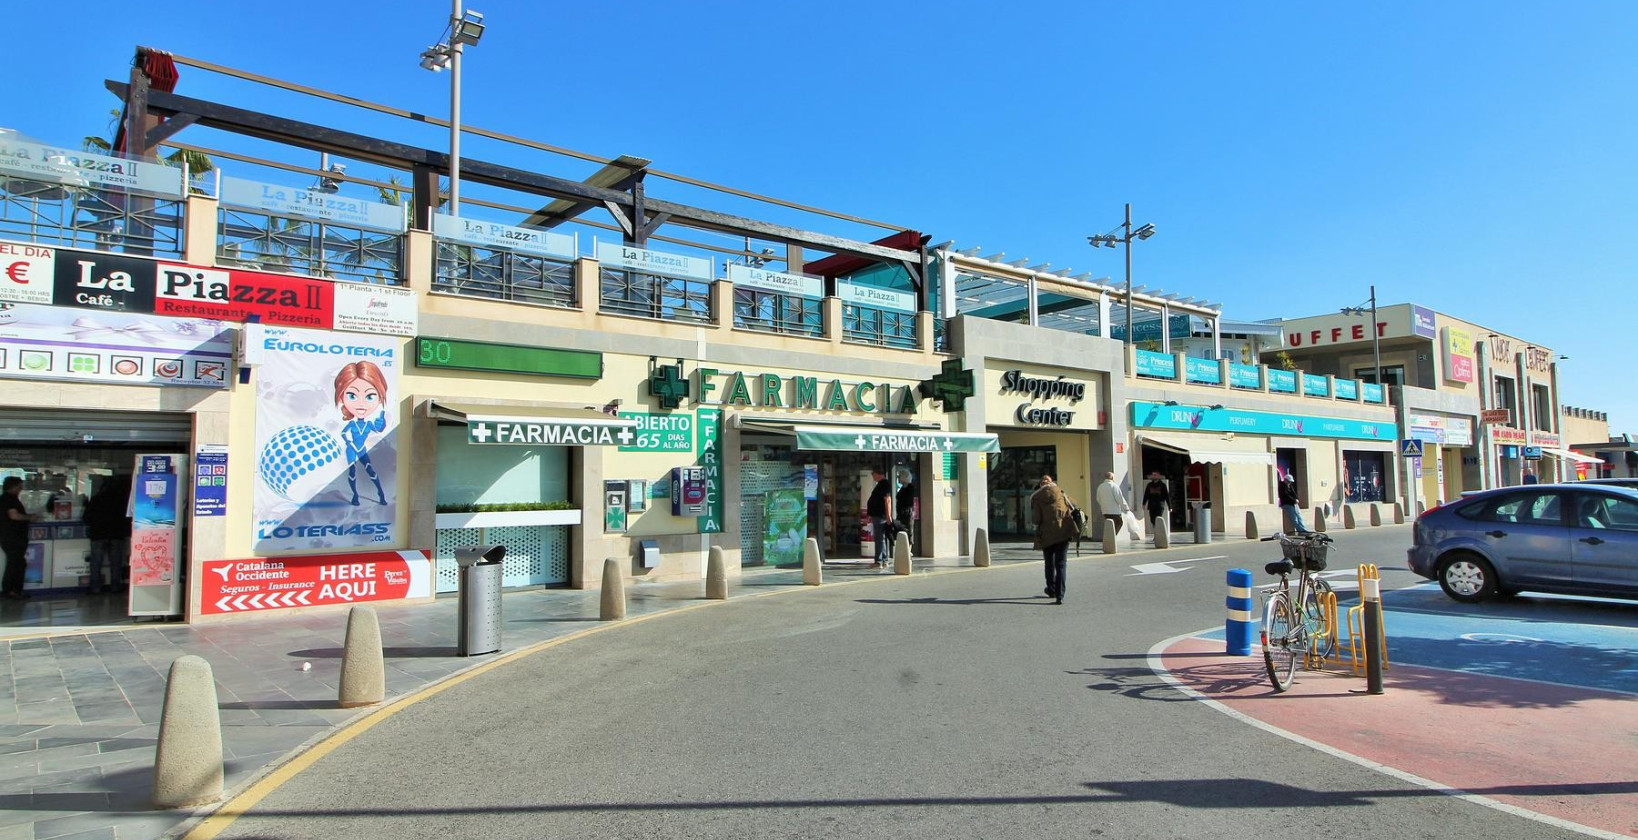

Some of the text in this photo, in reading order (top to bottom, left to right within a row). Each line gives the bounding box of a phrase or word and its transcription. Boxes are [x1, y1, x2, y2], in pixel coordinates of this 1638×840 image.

[261, 185, 286, 202] La
[295, 191, 357, 214] Piazza
[463, 220, 483, 233] La
[490, 225, 538, 243] Piazza
[623, 248, 637, 260] La
[642, 250, 681, 268] Piazza
[5, 261, 30, 285] €
[750, 270, 762, 280] La
[766, 272, 798, 286] Piazza
[77, 260, 322, 310] La Piazza II
[349, 284, 372, 292] Planta
[854, 287, 865, 295] La
[868, 289, 895, 302] Piazza
[76, 292, 321, 325] Café Restaurante Pizzeria
[1284, 322, 1387, 347] UFFET
[699, 368, 917, 414] FARMACIA
[1002, 370, 1085, 402] Shopping
[624, 415, 689, 431] BIERTO
[1016, 403, 1076, 426] Center
[1229, 416, 1256, 426] PERFUMERY
[496, 423, 614, 444] FARMACIA
[624, 432, 685, 448] 65 DIAS
[872, 435, 938, 450] FARMACIA
[673, 441, 690, 449] AÑO
[704, 426, 718, 531] FARMACIA
[257, 522, 392, 540] LOTERIASS
[235, 570, 290, 581] Occidente
[236, 561, 284, 571] Catalana
[320, 563, 376, 581] HERE
[219, 581, 315, 595] Seguros Insurance
[318, 581, 376, 601] AQUI
